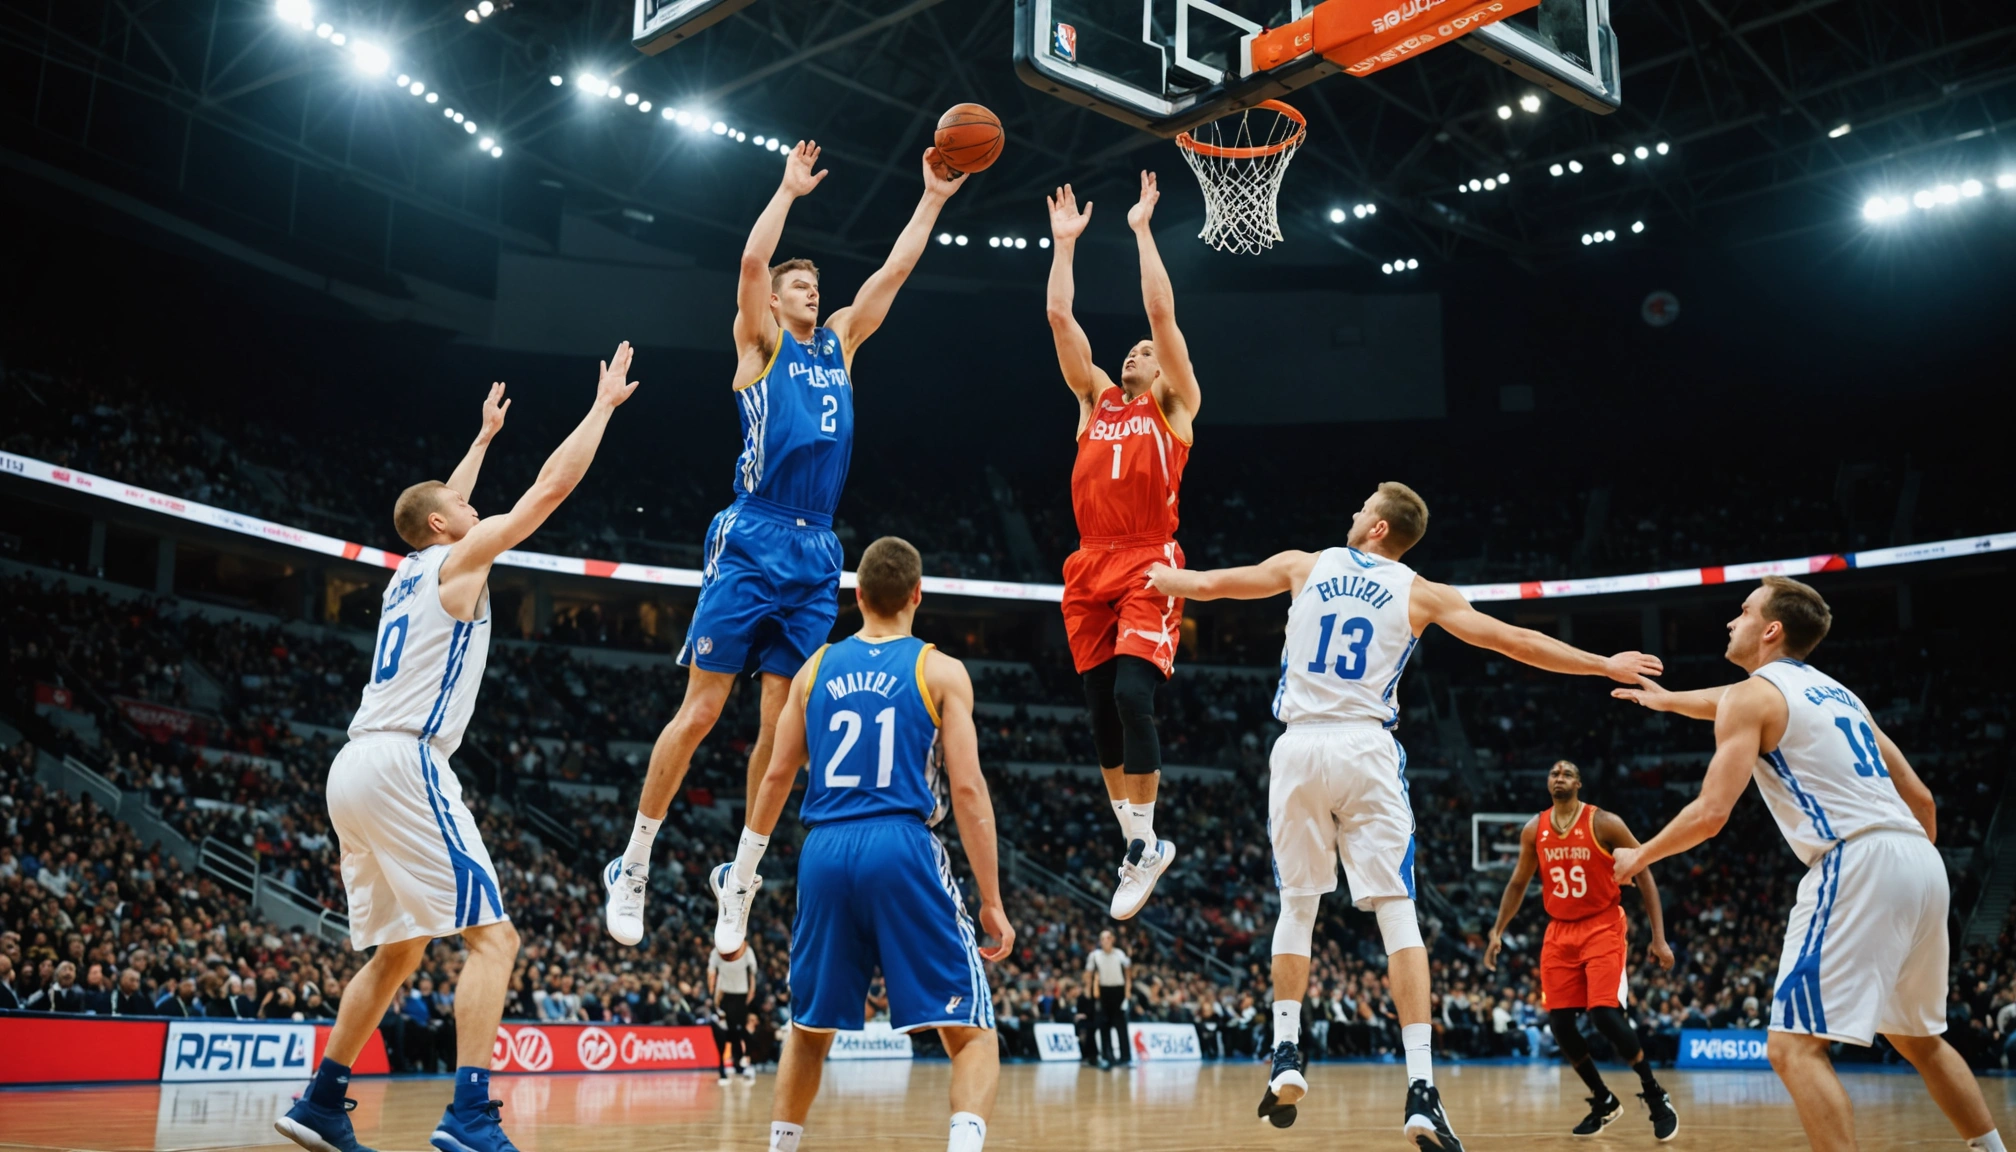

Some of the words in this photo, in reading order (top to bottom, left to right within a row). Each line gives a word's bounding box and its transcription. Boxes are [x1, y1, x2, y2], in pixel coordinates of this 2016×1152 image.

[821, 395, 838, 433] 2
[1111, 443, 1123, 480] 1
[375, 613, 409, 684] 0
[1307, 613, 1374, 680] 13
[825, 706, 896, 788] 21
